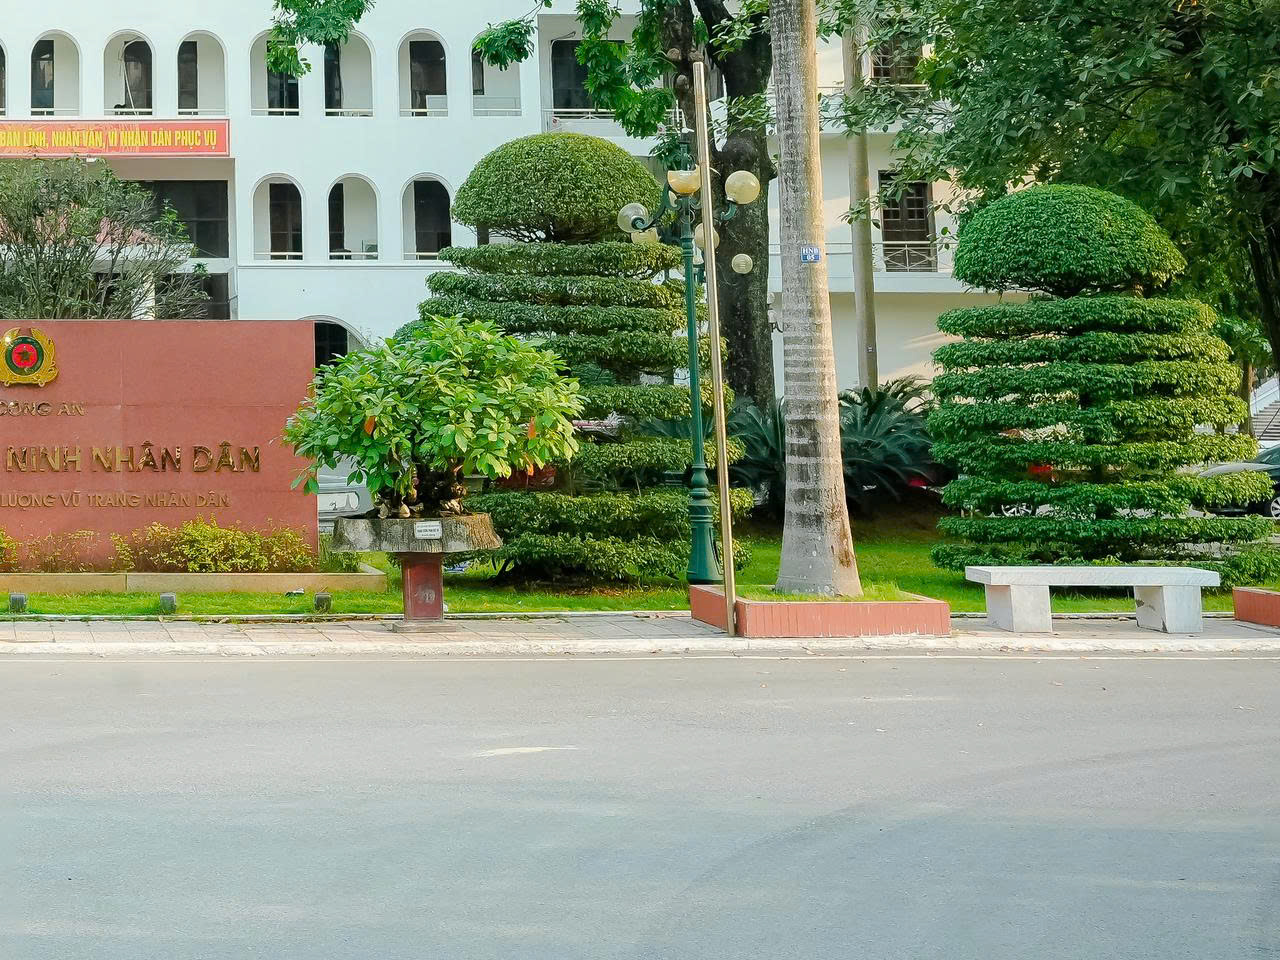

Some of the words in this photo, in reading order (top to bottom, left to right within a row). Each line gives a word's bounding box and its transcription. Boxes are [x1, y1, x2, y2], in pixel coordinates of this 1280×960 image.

[151, 127, 172, 147] DÂN
[174, 129, 201, 149] PHỤC
[204, 129, 217, 150] VỤ
[57, 401, 86, 417] AN
[6, 446, 82, 473] NINH
[91, 440, 182, 473] NHÂN
[193, 440, 261, 473] DÂN
[60, 490, 81, 507] VŨ
[87, 493, 141, 508] TRANG
[144, 491, 192, 507] NHÂN
[196, 489, 231, 507] DÂN
